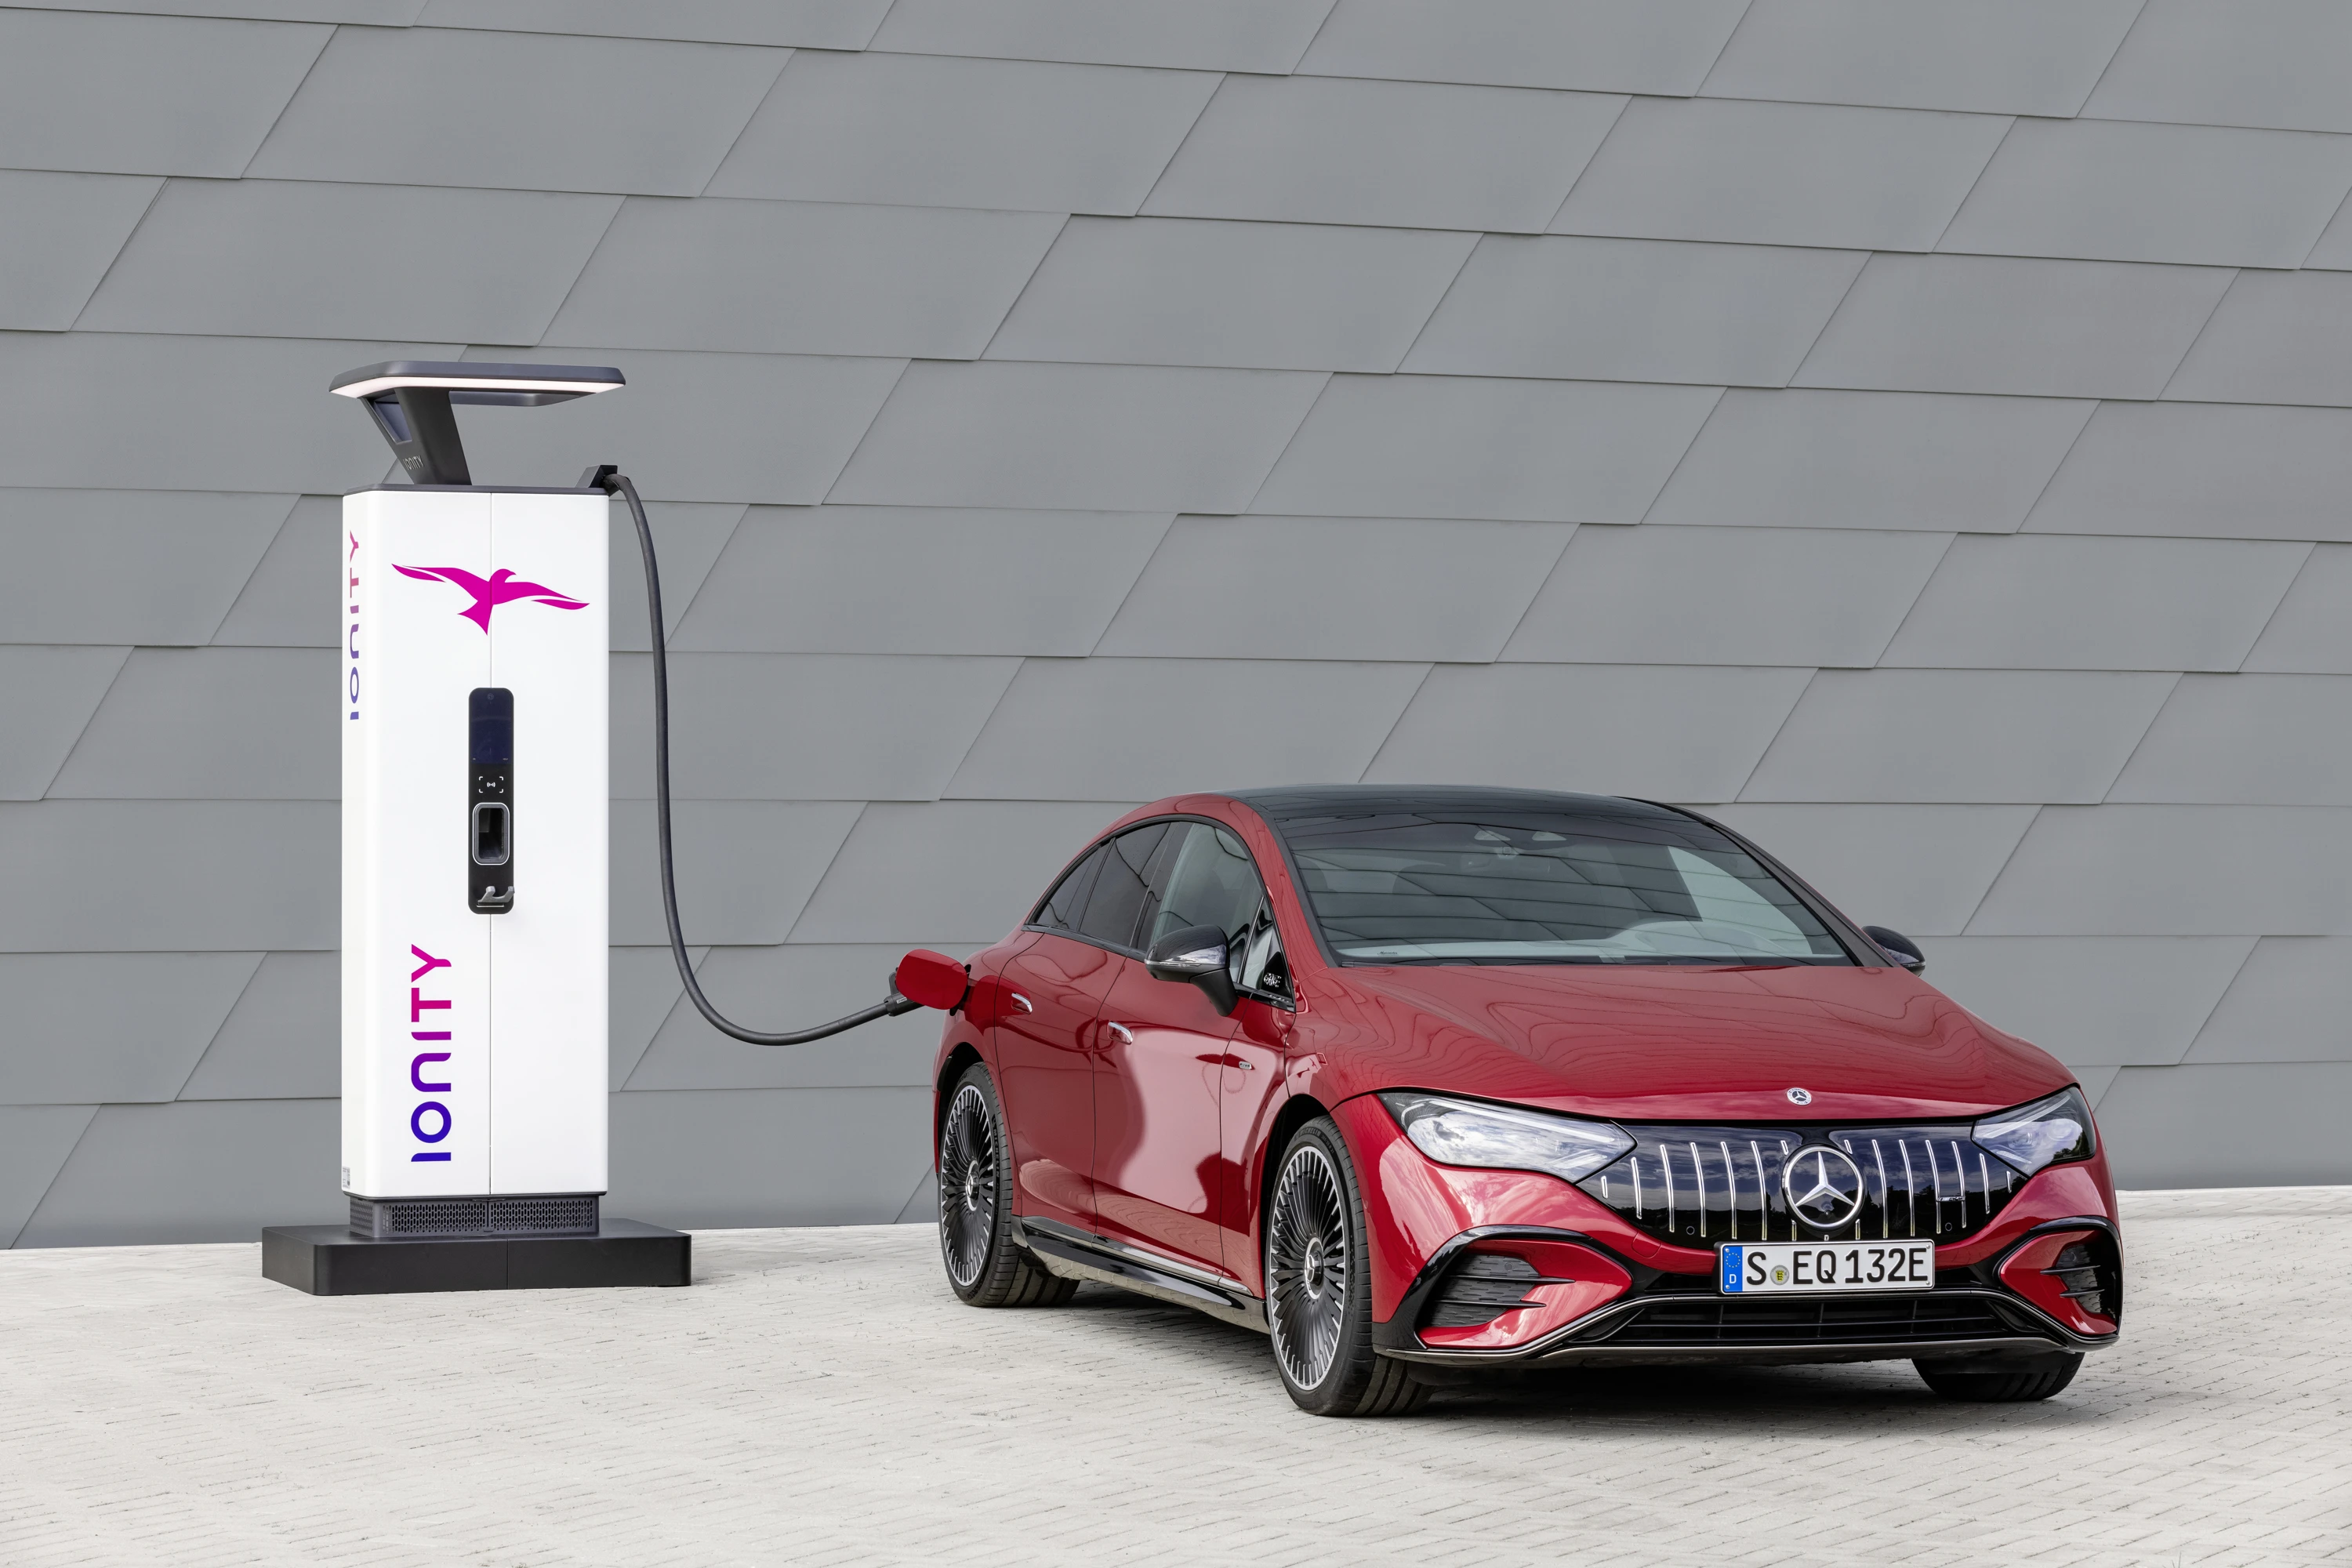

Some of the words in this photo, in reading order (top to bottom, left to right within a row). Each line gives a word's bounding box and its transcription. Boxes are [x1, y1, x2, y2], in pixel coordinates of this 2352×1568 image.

[402, 455, 424, 470] IONITY
[350, 529, 359, 720] IONITY
[411, 943, 452, 1162] IONITY
[1729, 1273, 1737, 1284] D
[1746, 1251, 1767, 1286] S
[1792, 1250, 1836, 1285] EQ
[1845, 1247, 1929, 1283] 132E
